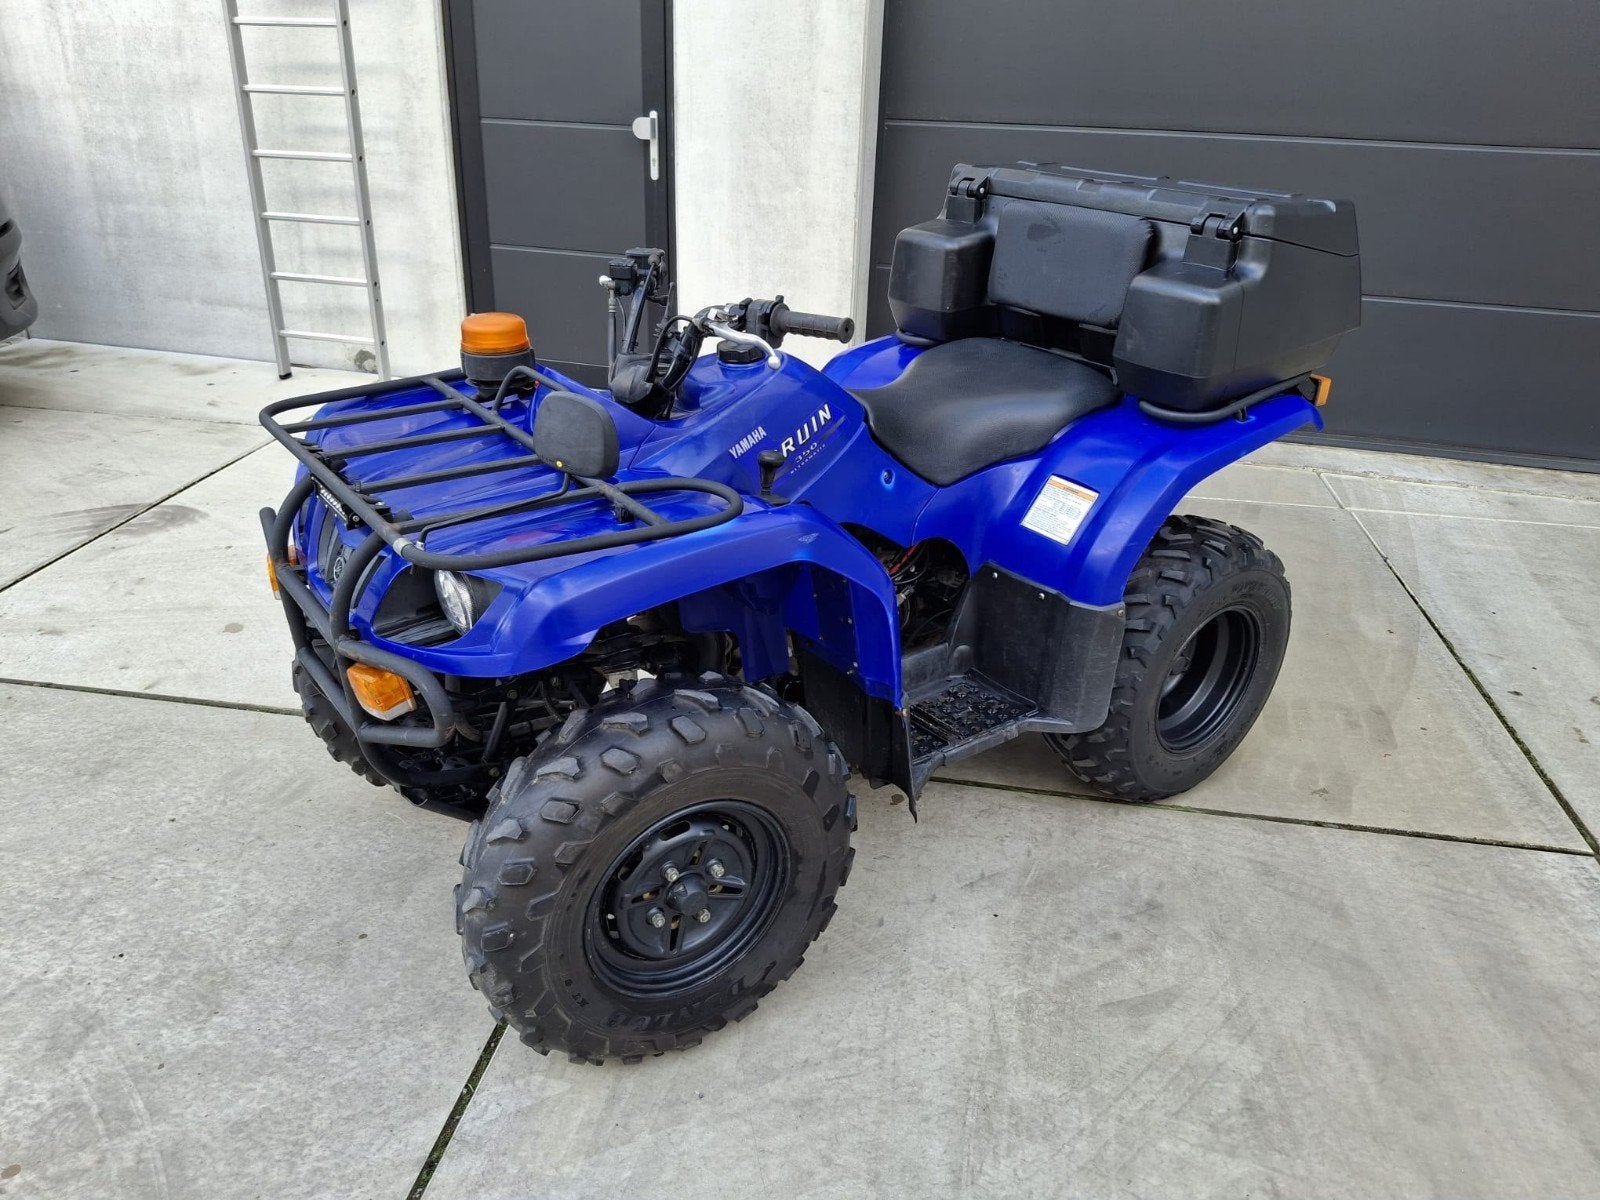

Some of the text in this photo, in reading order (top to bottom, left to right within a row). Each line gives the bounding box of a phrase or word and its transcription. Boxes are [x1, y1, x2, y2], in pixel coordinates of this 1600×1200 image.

[729, 426, 767, 459] YAMAHA
[778, 403, 832, 458] RUIN
[795, 442, 818, 463] 350
